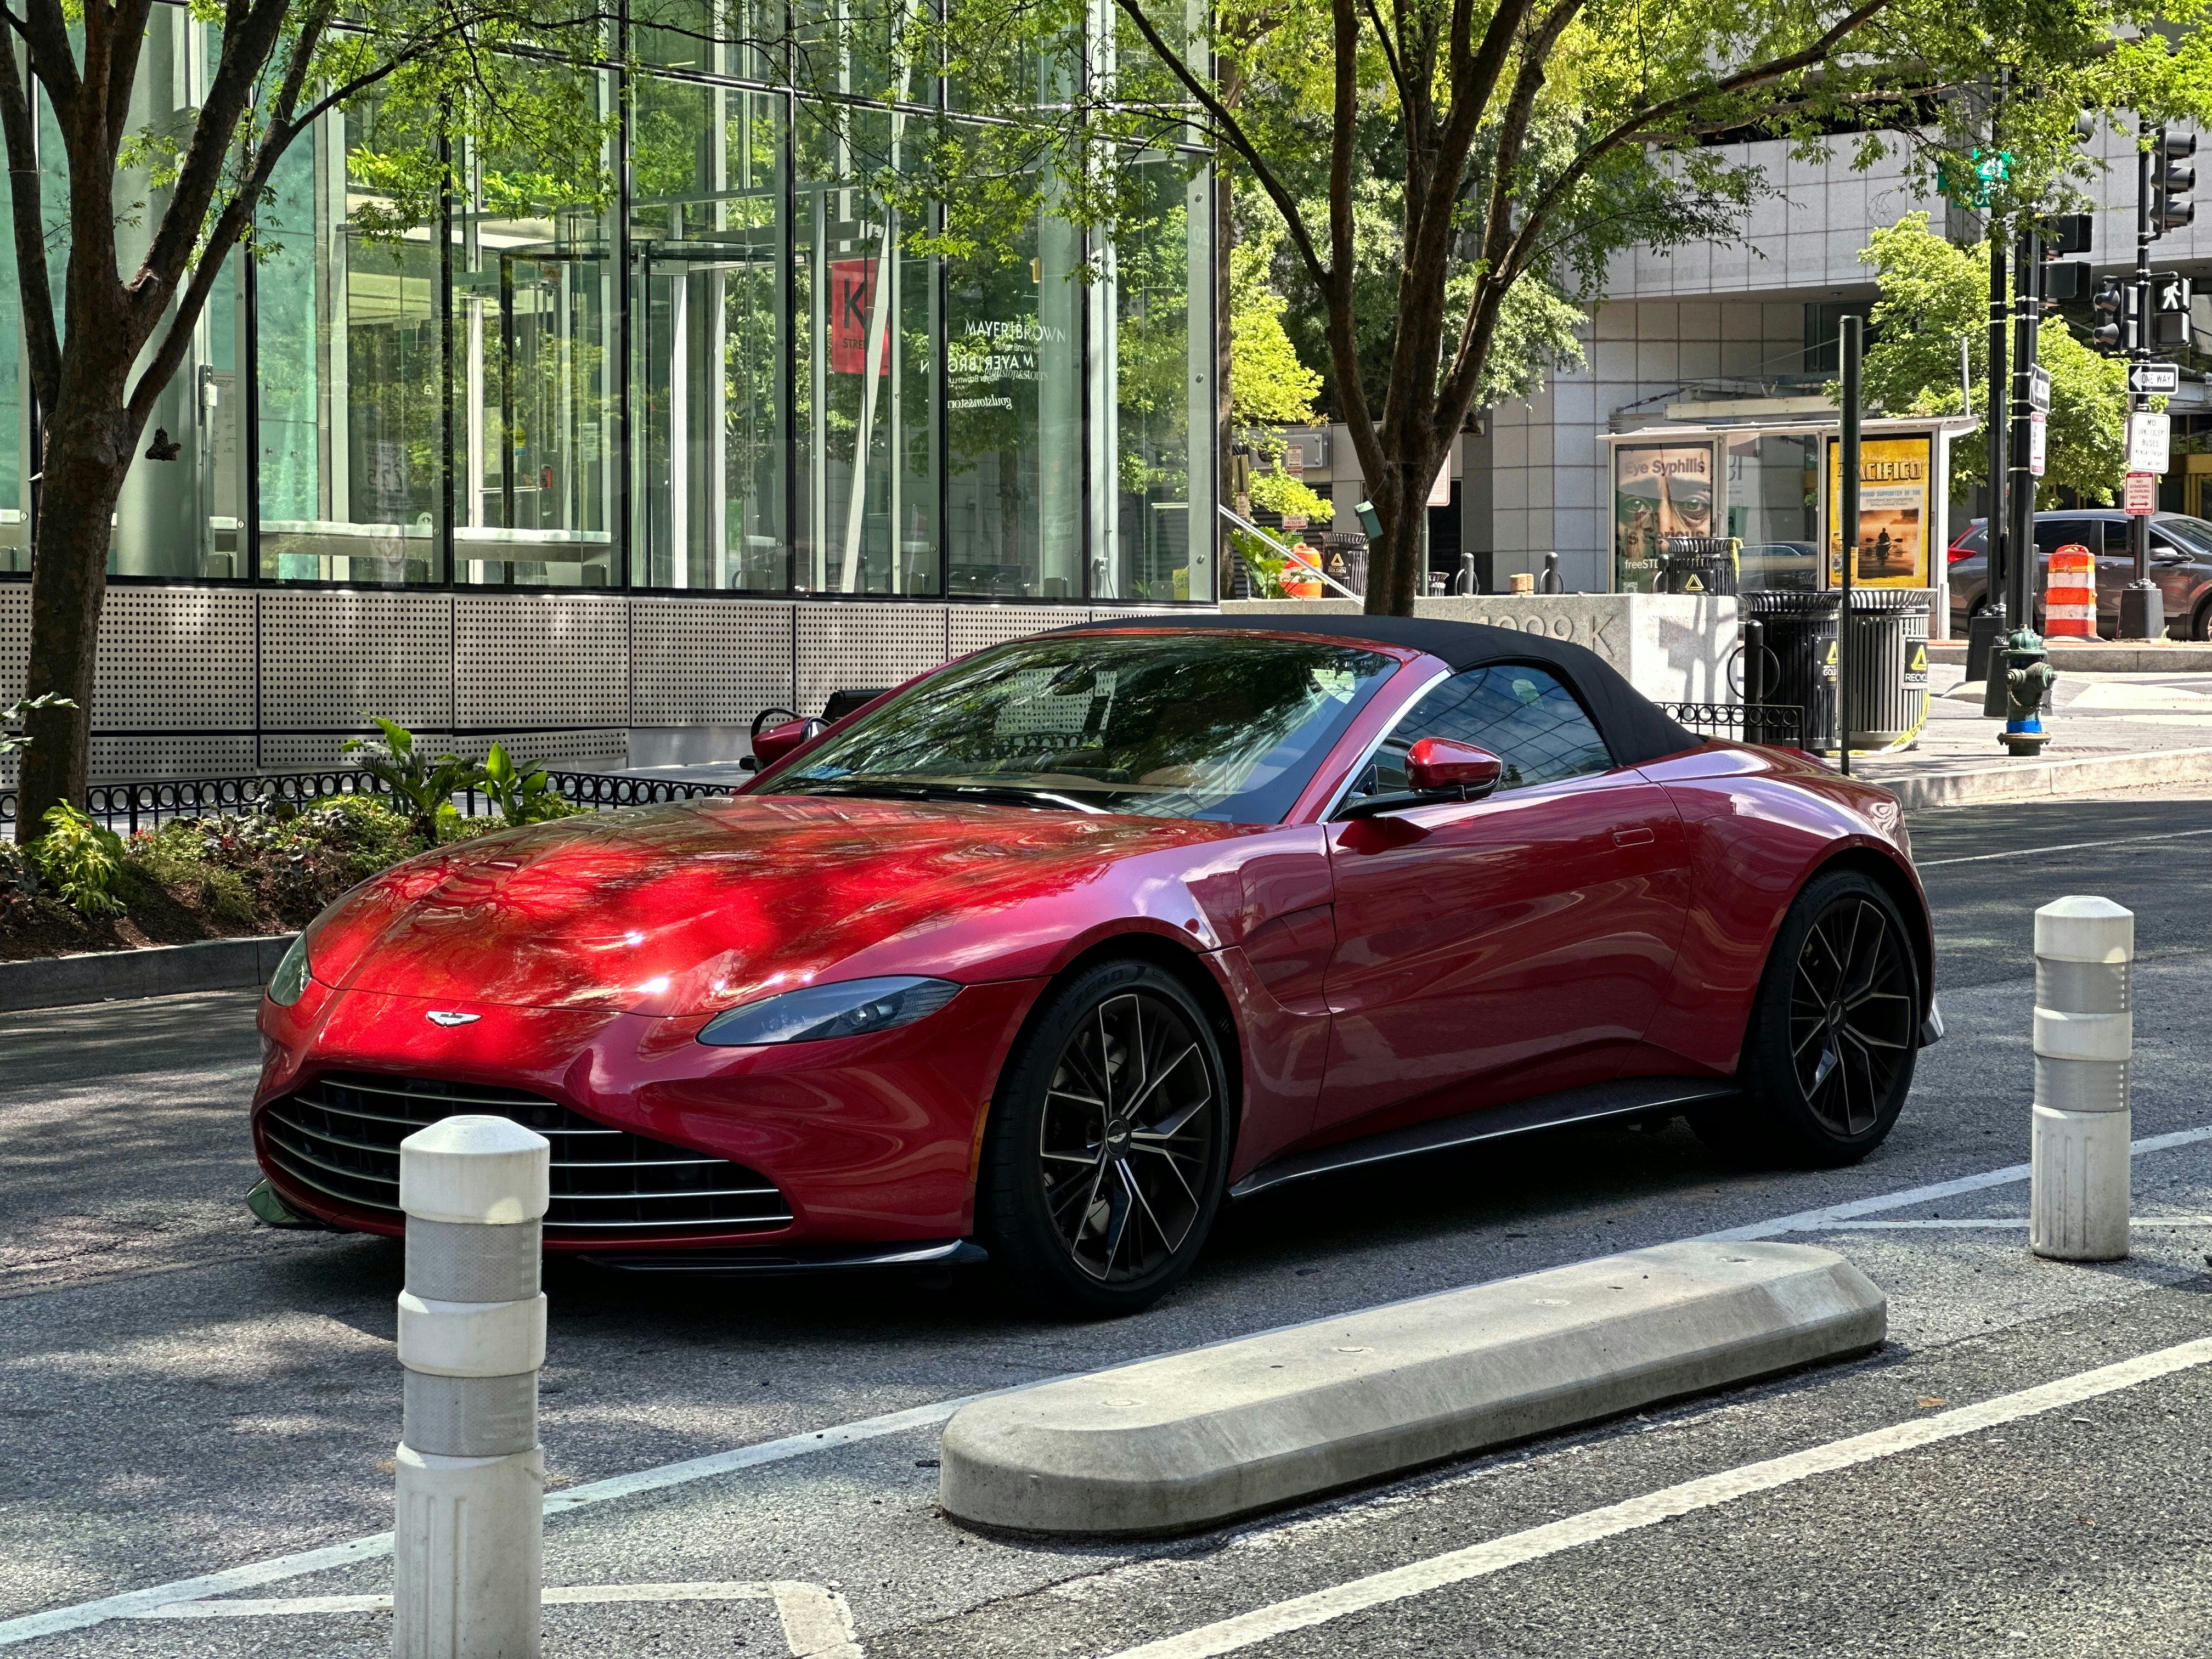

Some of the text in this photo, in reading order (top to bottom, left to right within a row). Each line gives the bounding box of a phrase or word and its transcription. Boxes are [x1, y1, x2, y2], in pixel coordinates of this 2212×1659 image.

[844, 278, 868, 329] K
[843, 337, 865, 349] STRE
[2141, 373, 2171, 384] ONE WAY
[2142, 439, 2159, 447] BUSES
[1625, 458, 1705, 477] Eye Syphilis
[1859, 461, 1922, 482] ACIFICO
[1479, 614, 1615, 658] 99 K
